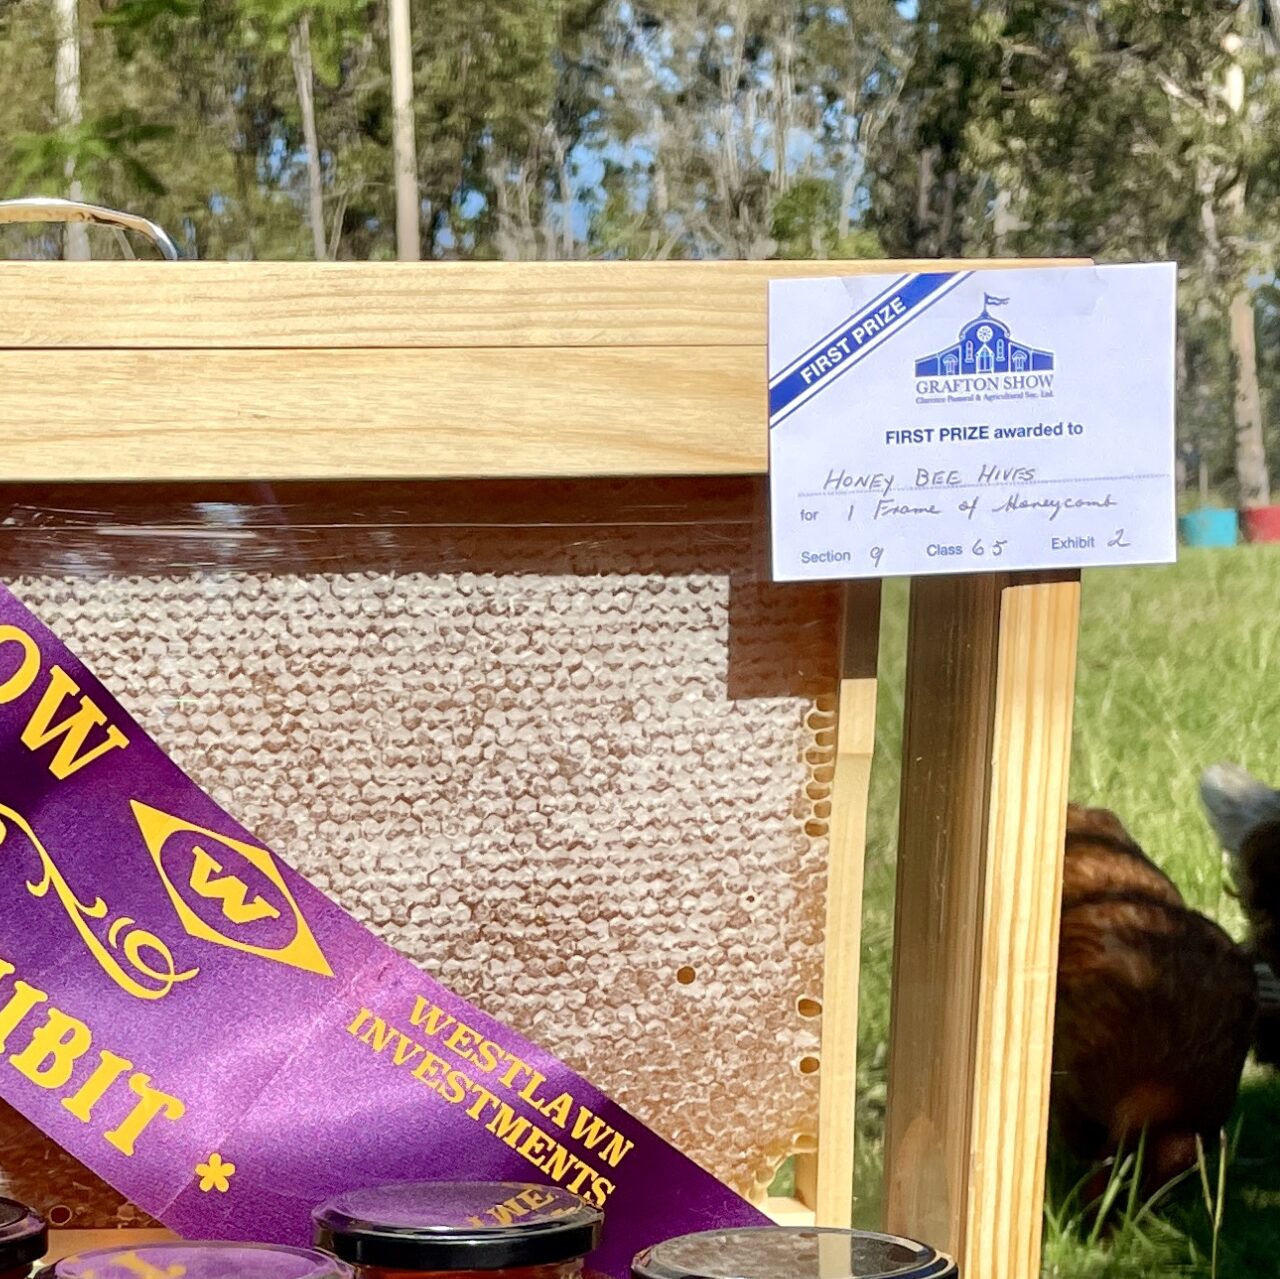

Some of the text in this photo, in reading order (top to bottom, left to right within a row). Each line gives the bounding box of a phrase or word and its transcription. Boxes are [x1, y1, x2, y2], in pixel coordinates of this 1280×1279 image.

[800, 295, 907, 384] FIRST PRIZE
[916, 374, 1054, 394] GRAFTON SHOW
[885, 422, 1083, 445] FIRST PRIZE awarded to
[823, 464, 1037, 495] HONEY BEE HIVES
[800, 509, 819, 522] for
[958, 497, 981, 520] of
[800, 550, 851, 564] Section
[926, 543, 963, 557] Class
[972, 540, 1008, 556] 65
[1051, 536, 1095, 550] Exhibit
[1107, 529, 1131, 548] 2
[189, 845, 280, 925] W
[409, 995, 634, 1168] WESTLAWN
[347, 1007, 615, 1207] INVESTMENTS
